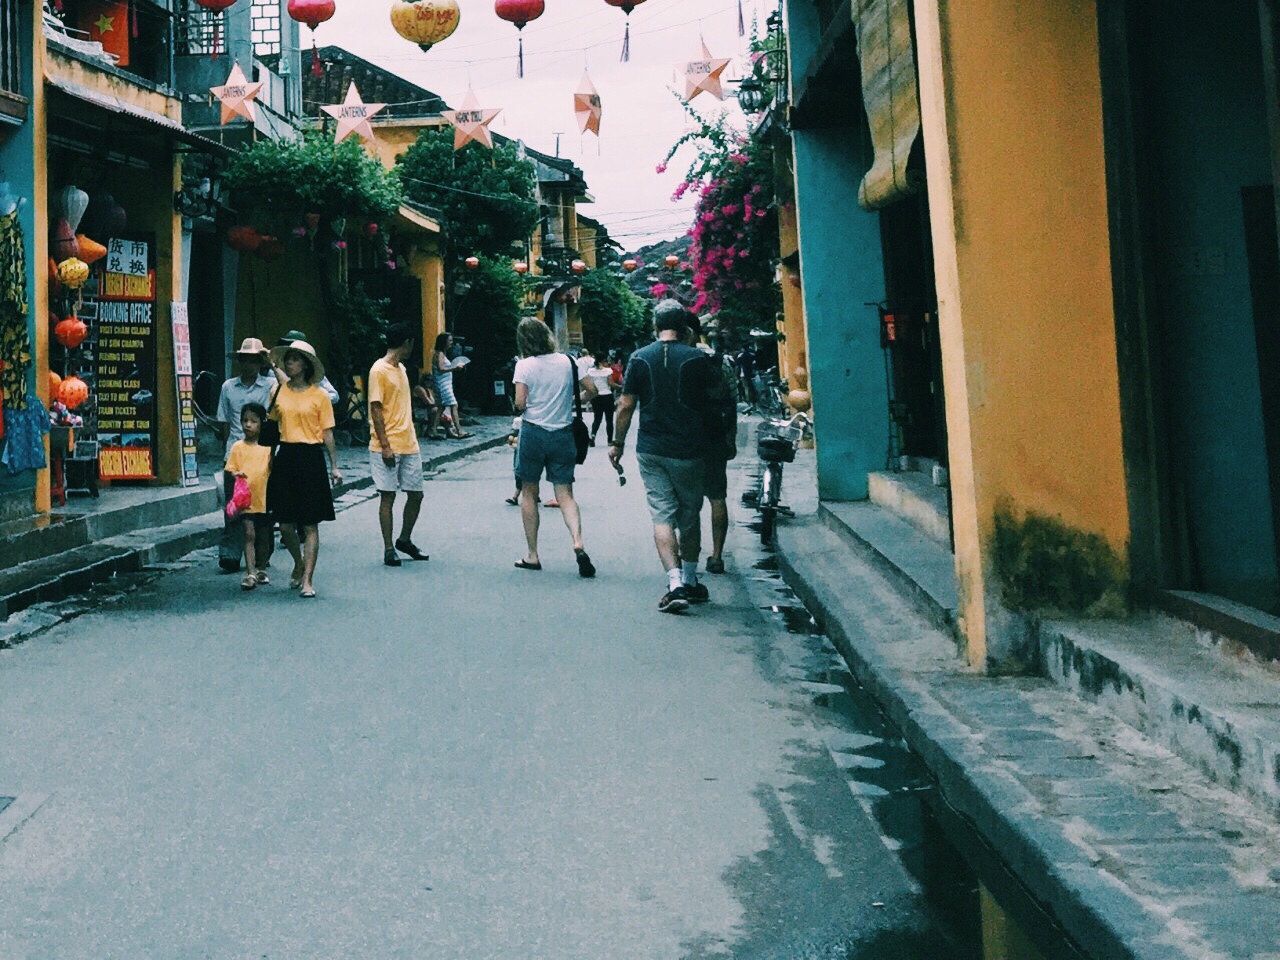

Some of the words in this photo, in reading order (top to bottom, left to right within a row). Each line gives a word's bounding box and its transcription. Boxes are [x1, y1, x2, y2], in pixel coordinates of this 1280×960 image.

[685, 61, 711, 74] ANTERNS
[221, 85, 246, 99] LANTERNS
[338, 106, 367, 118] LANTERNS
[100, 301, 129, 323] BOOKING
[130, 302, 152, 324] OFFICE
[100, 450, 122, 476] FOREIGN
[122, 450, 151, 476] EXCHANGE
